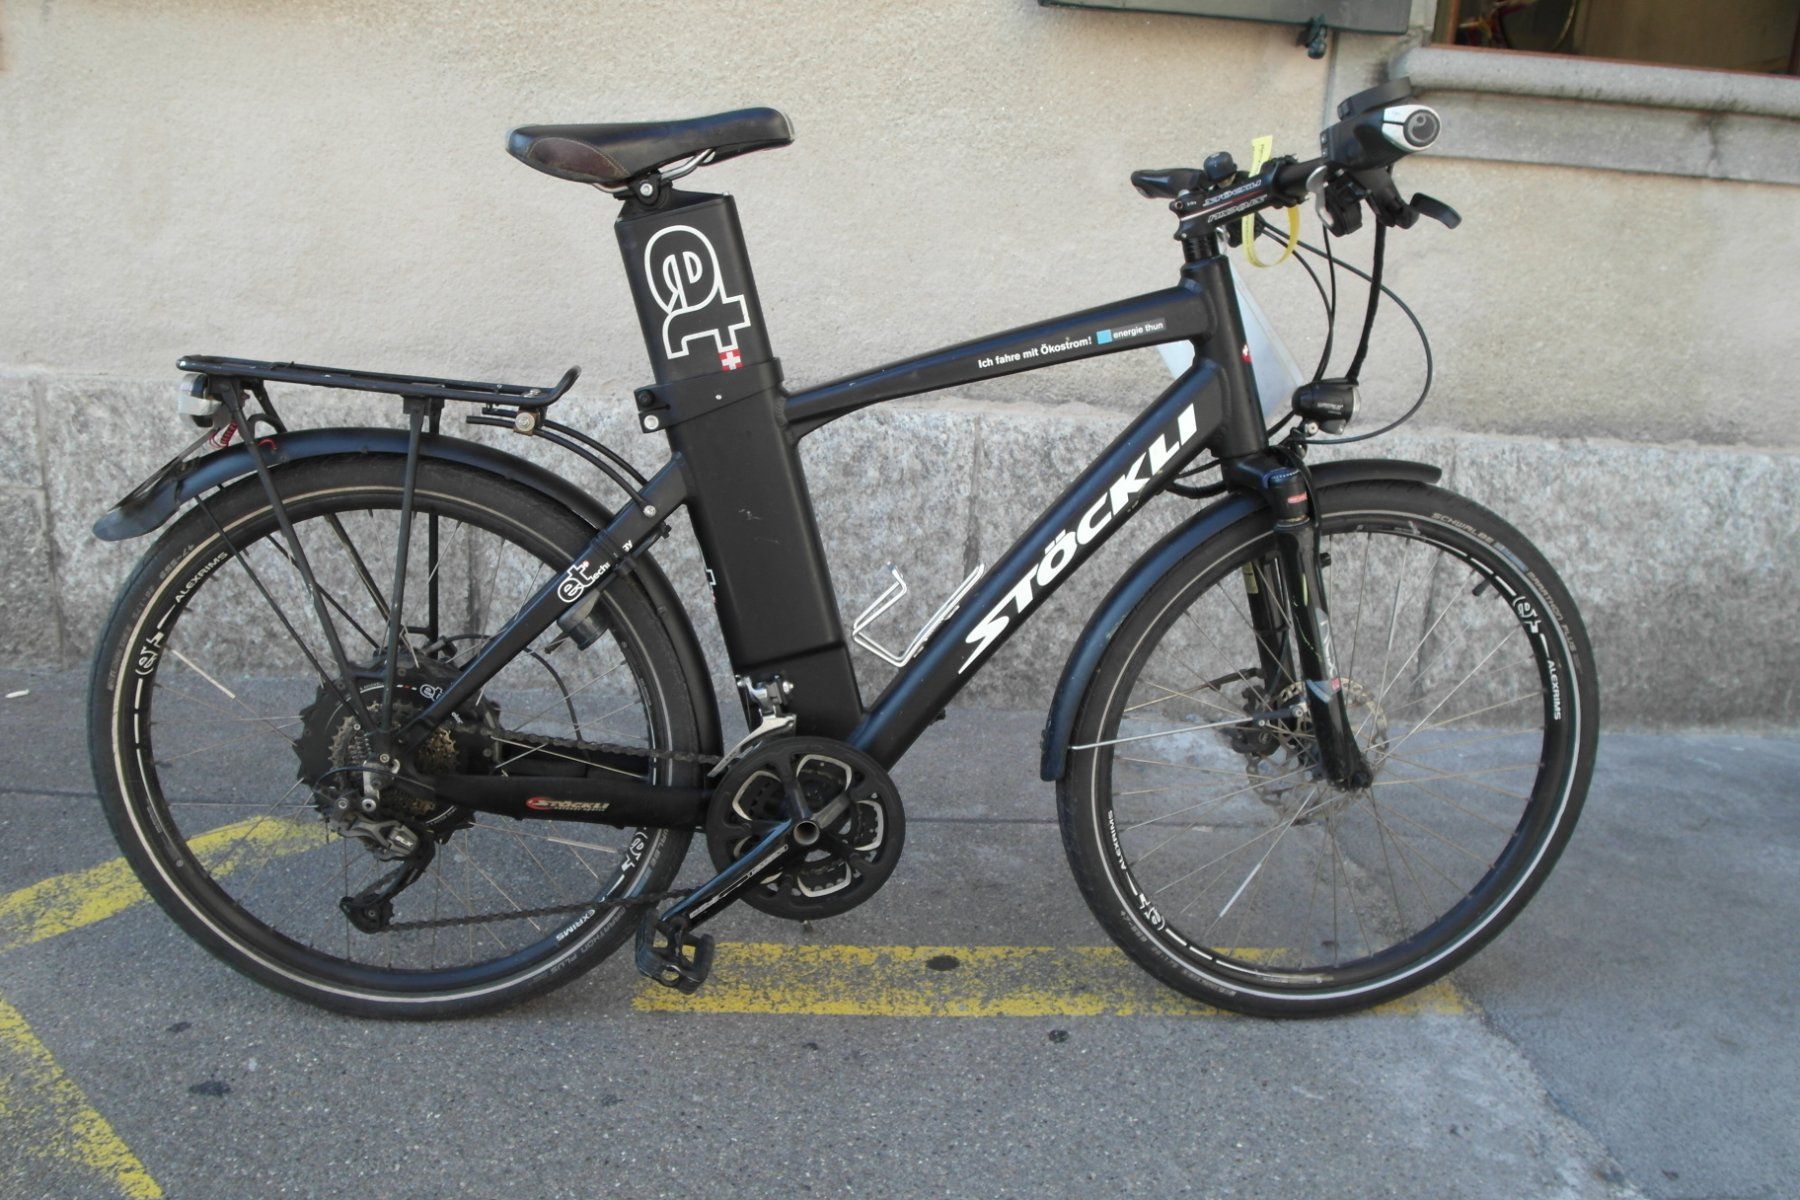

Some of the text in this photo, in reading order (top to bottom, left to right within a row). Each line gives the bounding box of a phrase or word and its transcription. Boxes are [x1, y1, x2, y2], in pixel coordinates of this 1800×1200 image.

[978, 336, 1092, 369] Ich fahre mit Ökostrom!
[1112, 321, 1164, 341] energie thun
[958, 402, 1197, 675] STÖCKLI
[1431, 512, 1495, 544] SCHWALBE
[175, 551, 228, 603] ALEXRIMS
[1547, 659, 1561, 721] ALEXRIMS
[1107, 810, 1127, 870] ALEXRIMS
